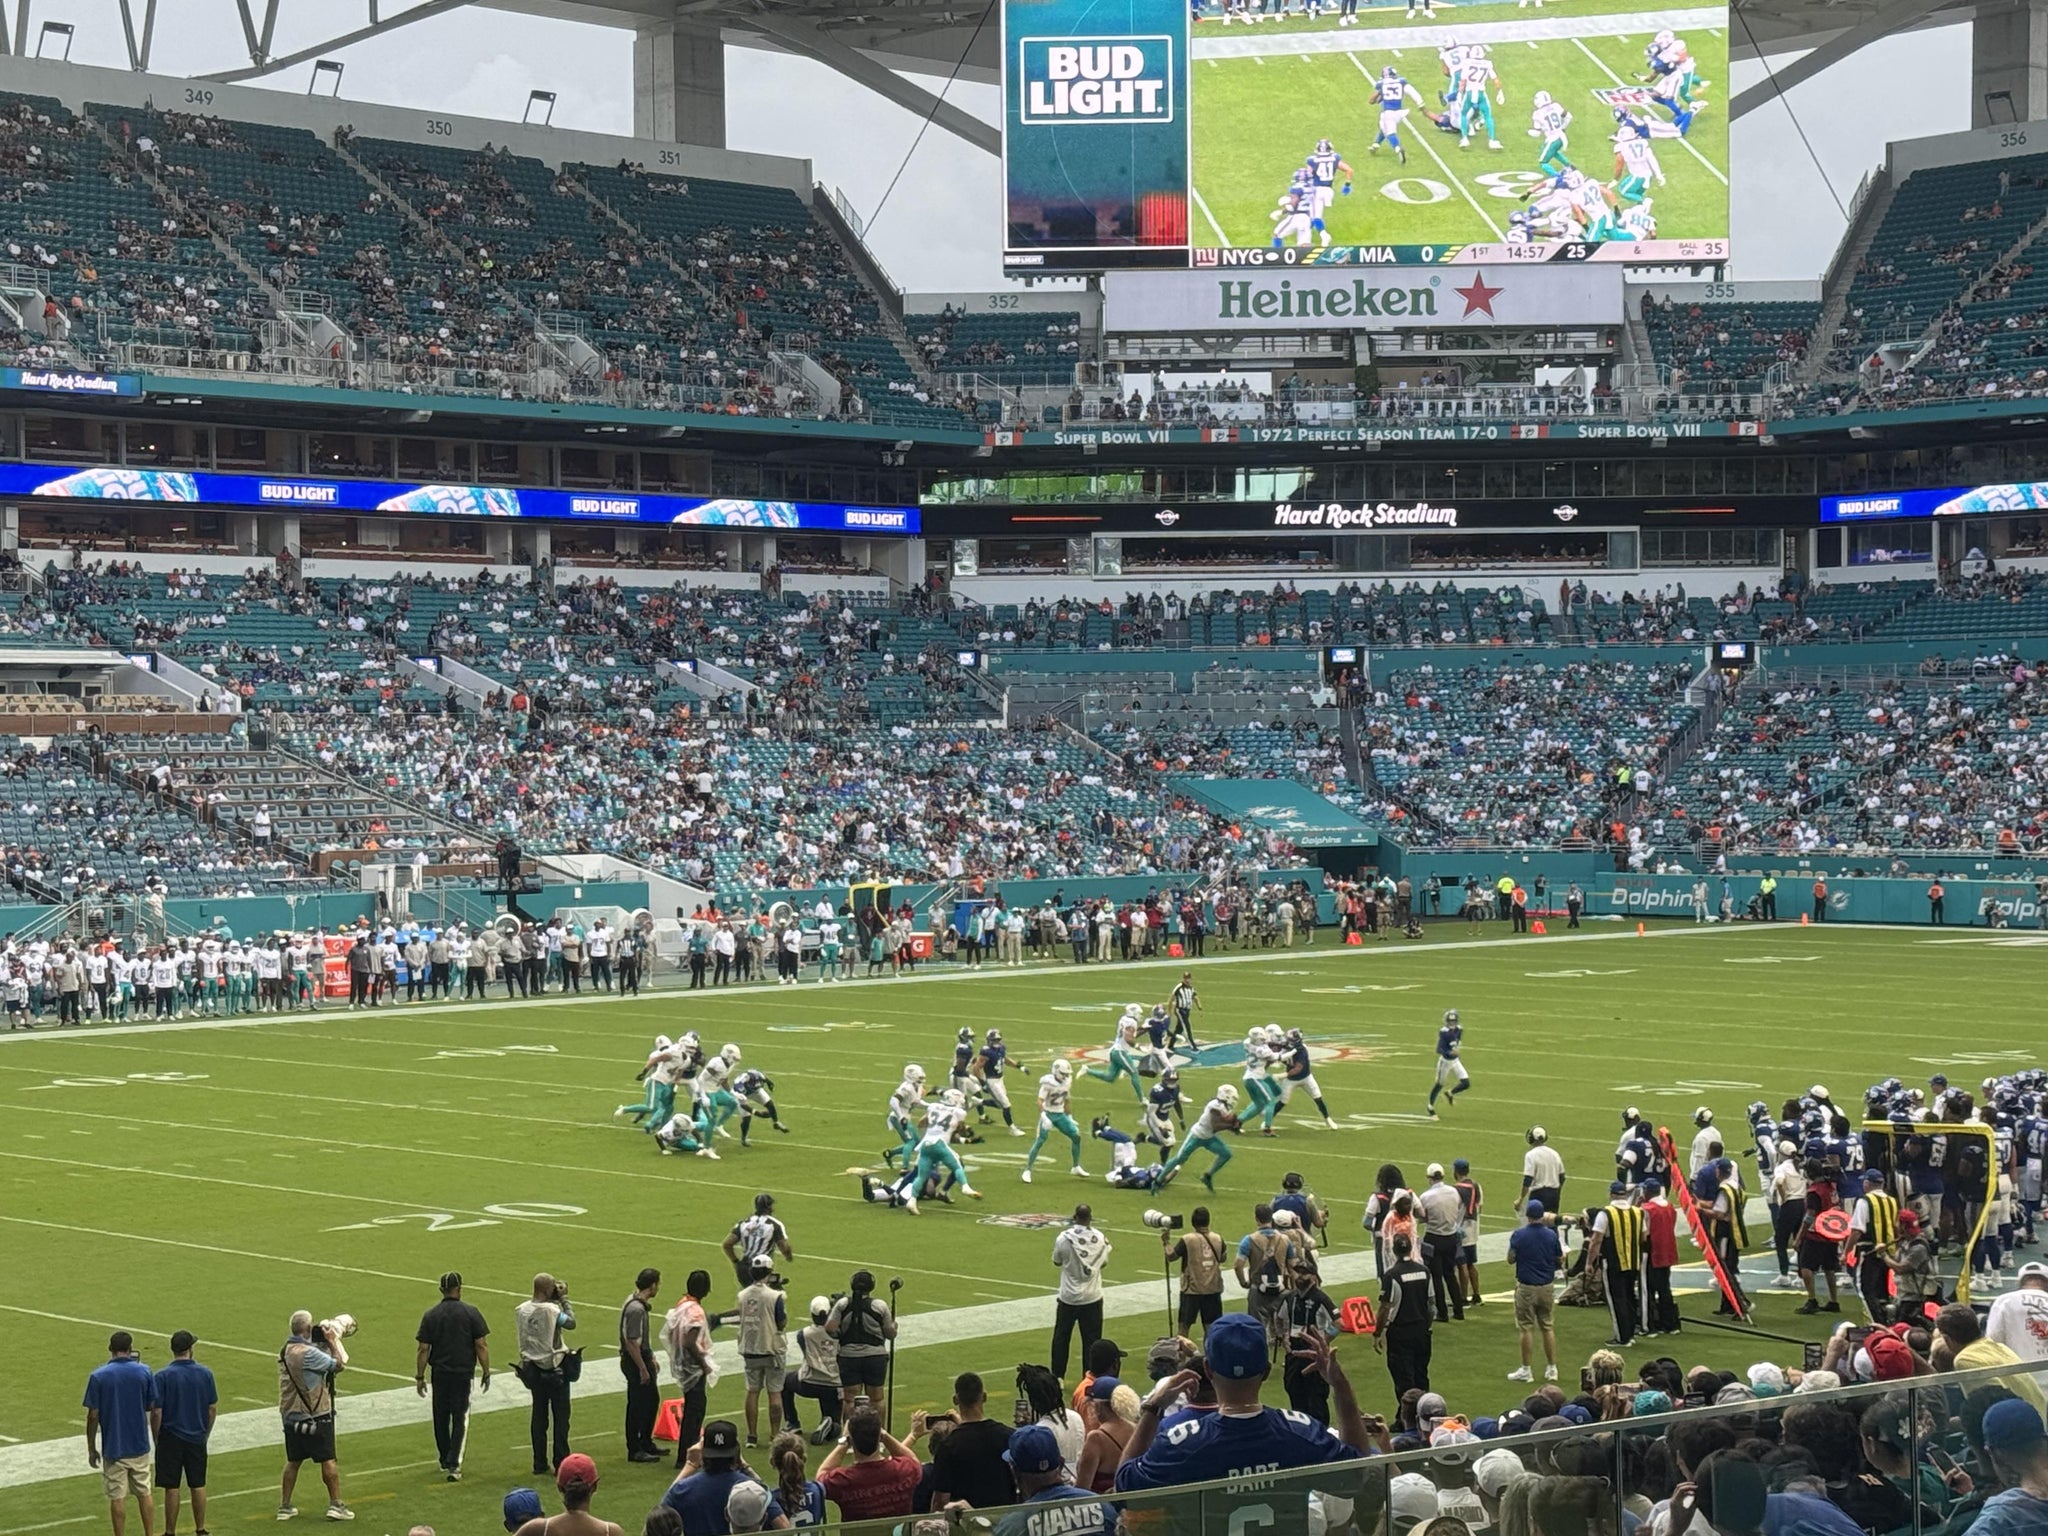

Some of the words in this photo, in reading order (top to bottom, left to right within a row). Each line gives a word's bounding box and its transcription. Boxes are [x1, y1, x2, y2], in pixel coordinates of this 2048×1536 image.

[1048, 46, 1144, 80] BUD
[1468, 66, 1488, 83] 27
[184, 89, 214, 105] 349
[1382, 85, 1401, 99] 53
[426, 120, 453, 136] 350
[1545, 112, 1562, 130] 19
[2000, 131, 2027, 147] 356
[658, 150, 681, 166] 351
[1628, 143, 1643, 159] 17
[1316, 162, 1334, 181] 41
[1583, 186, 1601, 207] 42
[1222, 249, 1263, 265] NYG
[1284, 249, 1296, 265] 0
[1359, 247, 1396, 263] MIA
[1421, 246, 1434, 262] 0
[1506, 246, 1545, 260] 14:57
[1566, 245, 1586, 259] 25
[1705, 242, 1723, 256] 35
[1705, 284, 1735, 299] 355
[988, 295, 1019, 308] 352
[21, 371, 48, 387] Hard
[48, 373, 74, 389] Rock
[73, 376, 117, 392] Stadium
[1148, 429, 1170, 443] VII
[1251, 428, 1293, 442] 1972
[1461, 425, 1498, 440] 17-0
[1673, 422, 1700, 437] VIII
[261, 484, 293, 498] BUD
[294, 485, 335, 501] LIGHT
[572, 498, 600, 513] BUD
[600, 499, 636, 515] LIGHT
[1838, 500, 1865, 514] BUD
[1865, 498, 1900, 512] LIGHT
[846, 510, 871, 525] BUD
[870, 511, 904, 526] LIGHT
[1274, 503, 1326, 525] Hard
[1326, 502, 1374, 529] Rock
[1373, 502, 1457, 528] Stadium
[929, 1111, 951, 1132] 34
[1847, 1144, 1865, 1172] 79
[371, 1202, 588, 1231] 20
[1351, 1302, 1376, 1329] 20
[1027, 1503, 1104, 1536] GIANTS
